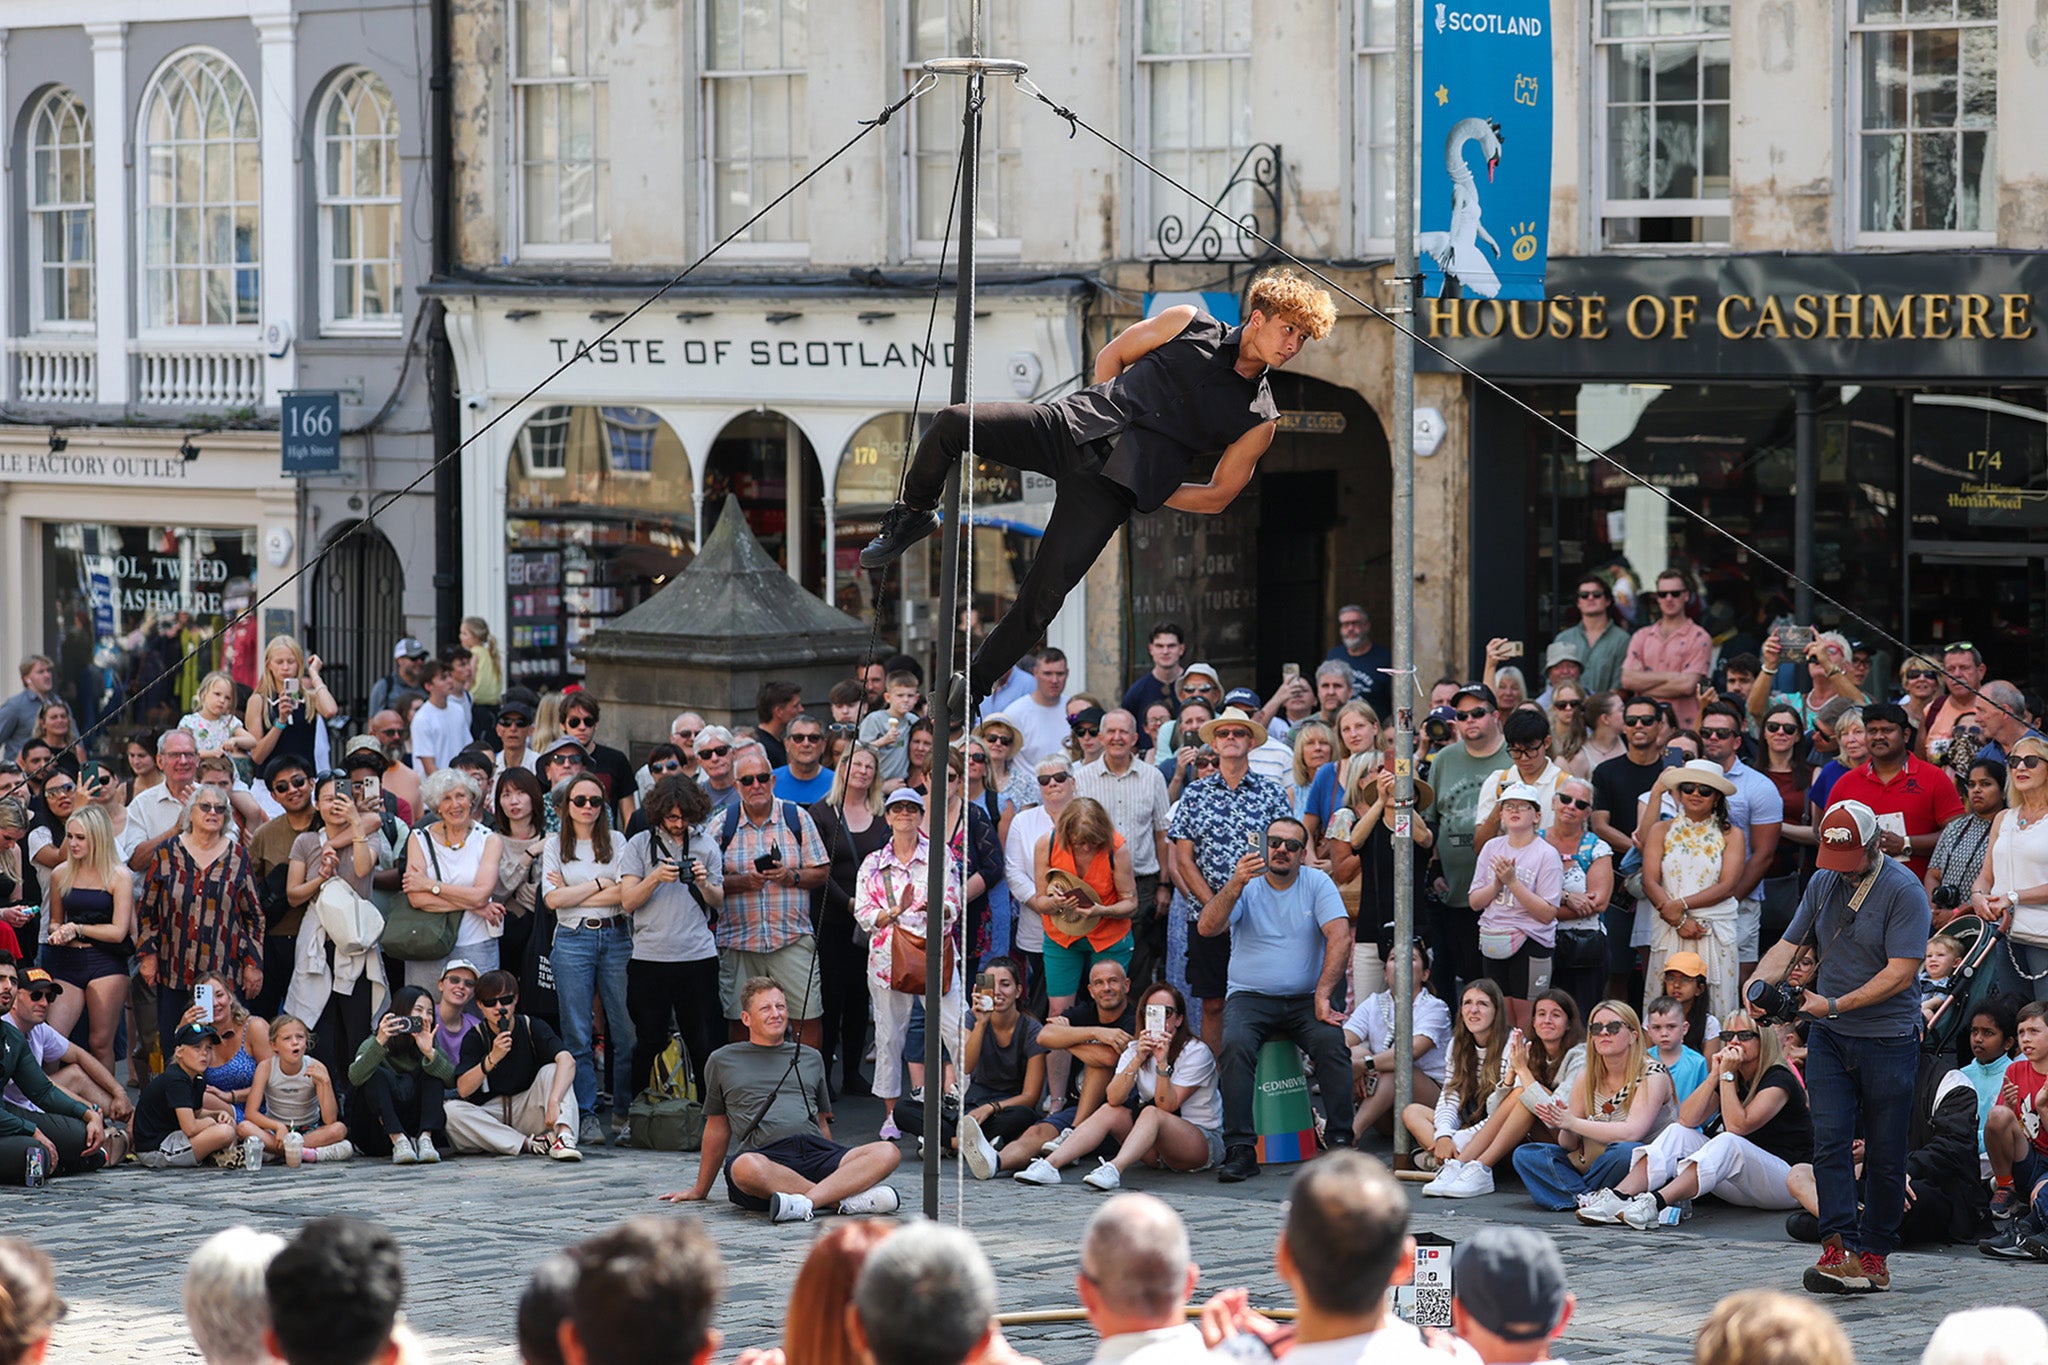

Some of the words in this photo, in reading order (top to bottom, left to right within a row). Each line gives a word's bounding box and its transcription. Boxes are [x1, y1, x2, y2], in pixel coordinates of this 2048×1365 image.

[1449, 12, 1541, 36] SCOTLAND
[1428, 294, 1608, 339] HOUSE
[1626, 294, 1698, 339] OF
[1717, 293, 2033, 340] CASHMERE
[550, 339, 665, 364] TASTE
[684, 340, 731, 364] OF
[290, 405, 332, 437] 166
[287, 445, 308, 460] High
[310, 444, 335, 457] Street
[854, 447, 878, 466] 170
[1968, 450, 2002, 471] 174
[28, 454, 107, 475] FACTORY
[113, 457, 187, 478] OUTLET
